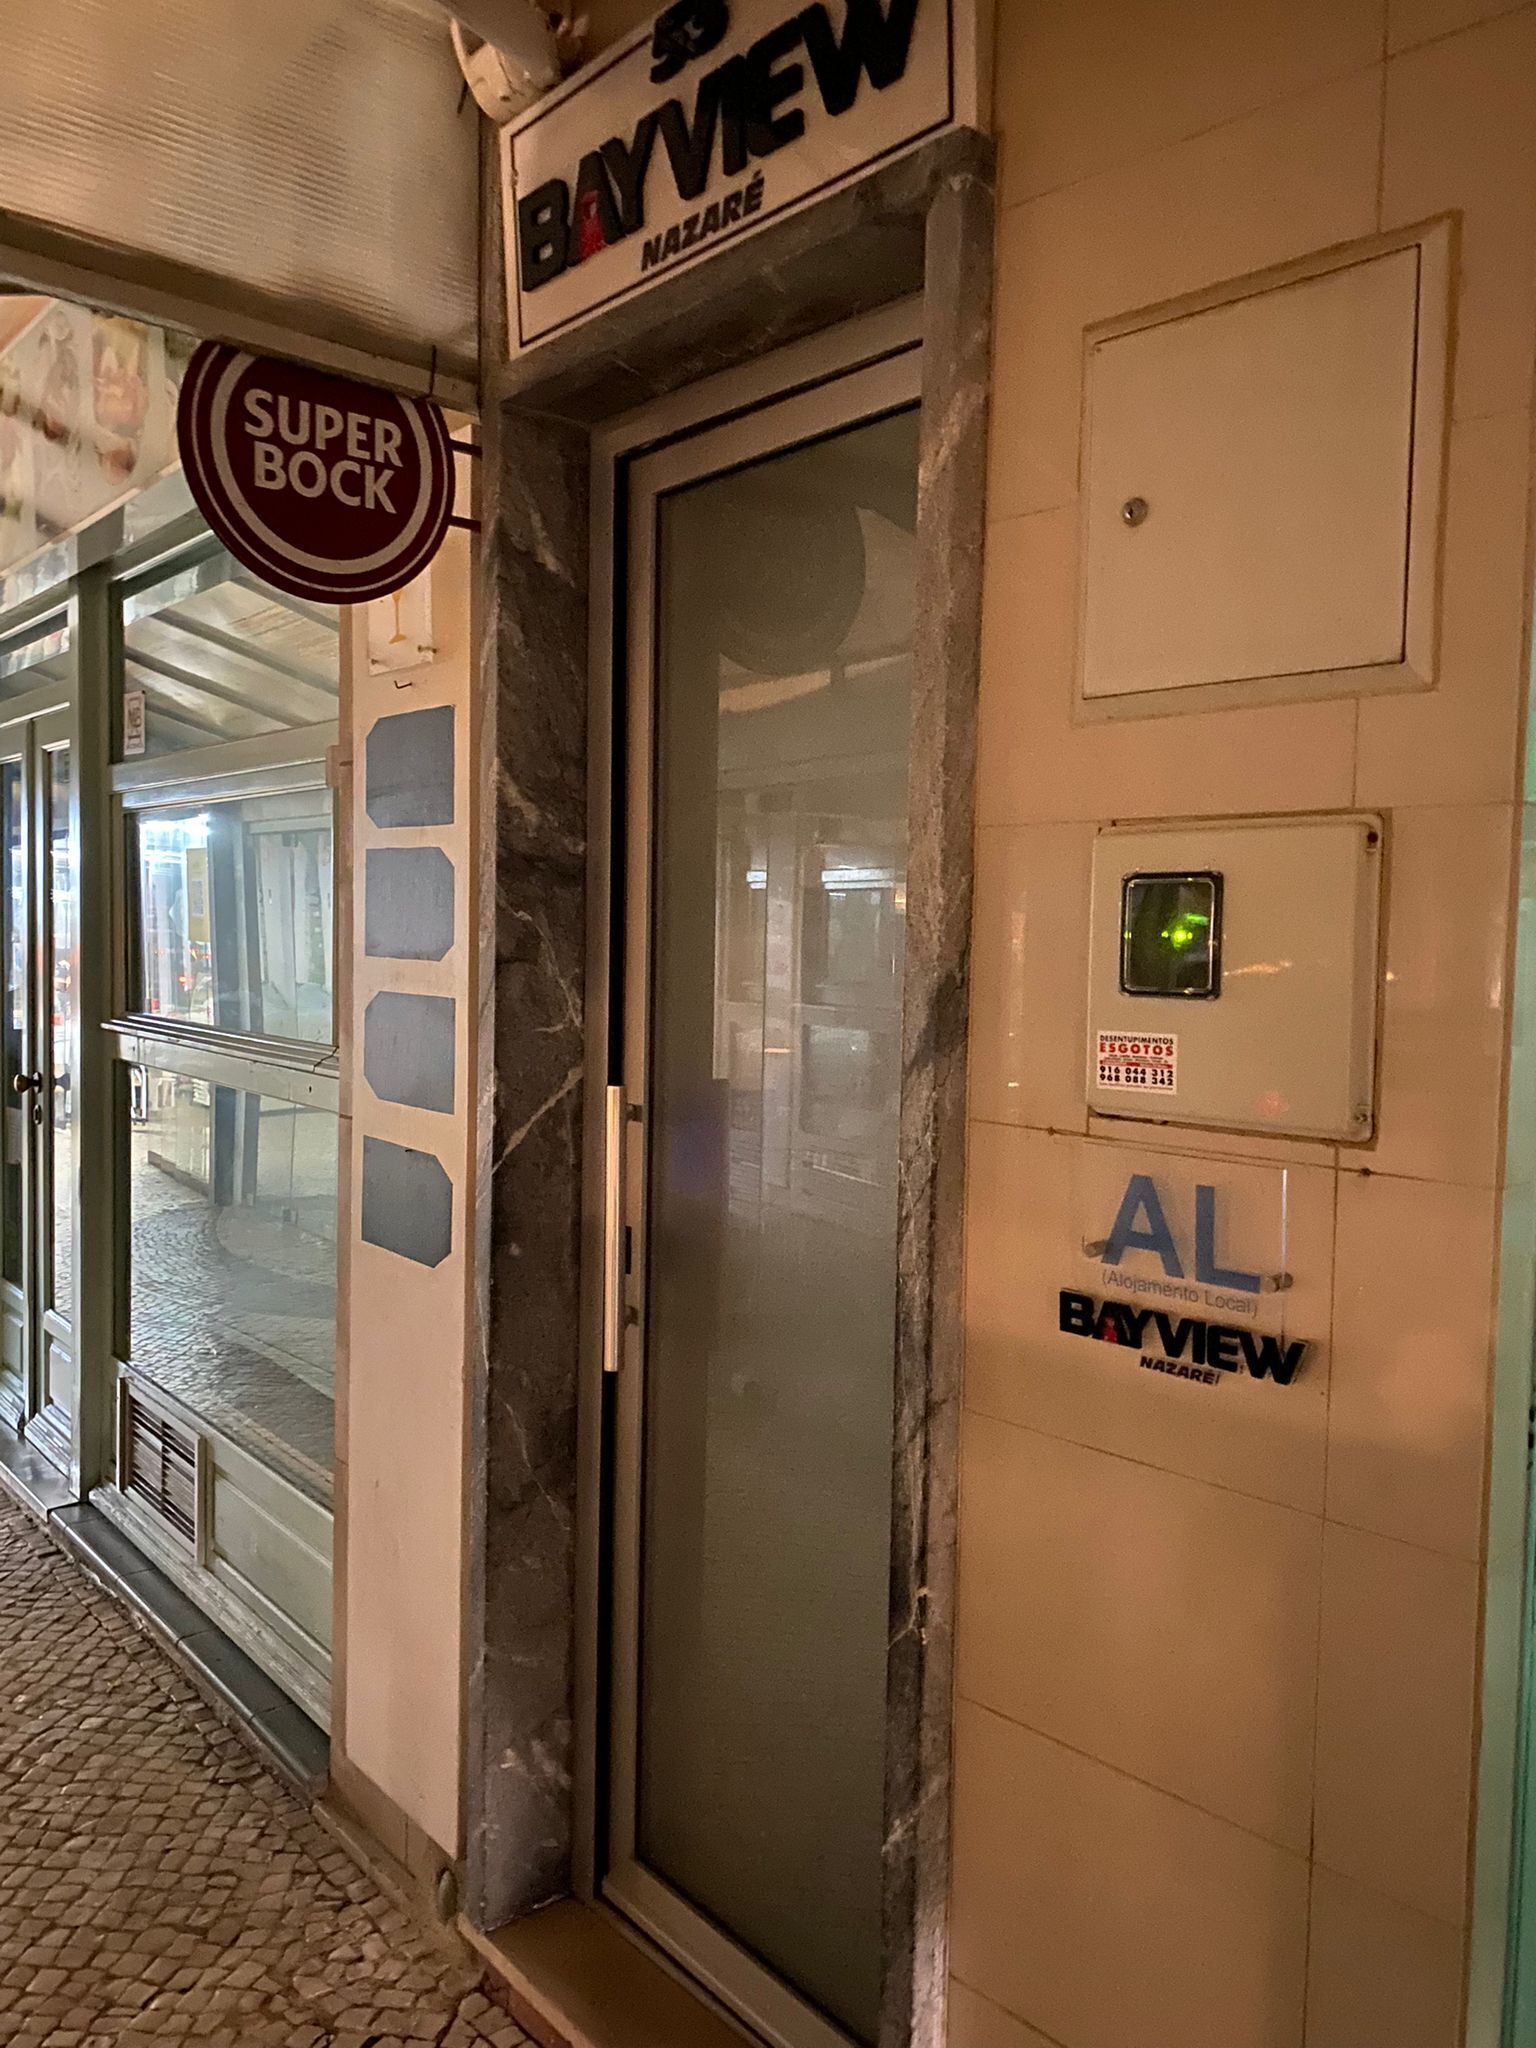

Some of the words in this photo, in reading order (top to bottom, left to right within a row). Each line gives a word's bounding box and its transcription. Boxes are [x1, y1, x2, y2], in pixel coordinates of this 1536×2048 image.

[518, 0, 918, 292] BAYVIEW
[641, 169, 764, 272] NAZARÉ
[244, 388, 404, 468] SUPER
[254, 440, 397, 515] BOCK
[1100, 1035, 1174, 1045] DESENTUPIMENTOS
[1100, 1042, 1174, 1056] ESGOTOS
[1100, 1066, 1120, 1074] 916
[1125, 1068, 1146, 1076] 044
[1151, 1069, 1173, 1078] 312
[1100, 1073, 1120, 1082] 968
[1151, 1077, 1173, 1086] 342
[1101, 1173, 1261, 1294] AL
[1102, 1269, 1199, 1303] (Alojamento
[1204, 1289, 1258, 1319] Local)
[1059, 1289, 1307, 1386] BAYVIEW
[1140, 1355, 1216, 1385] NAZARÉ
